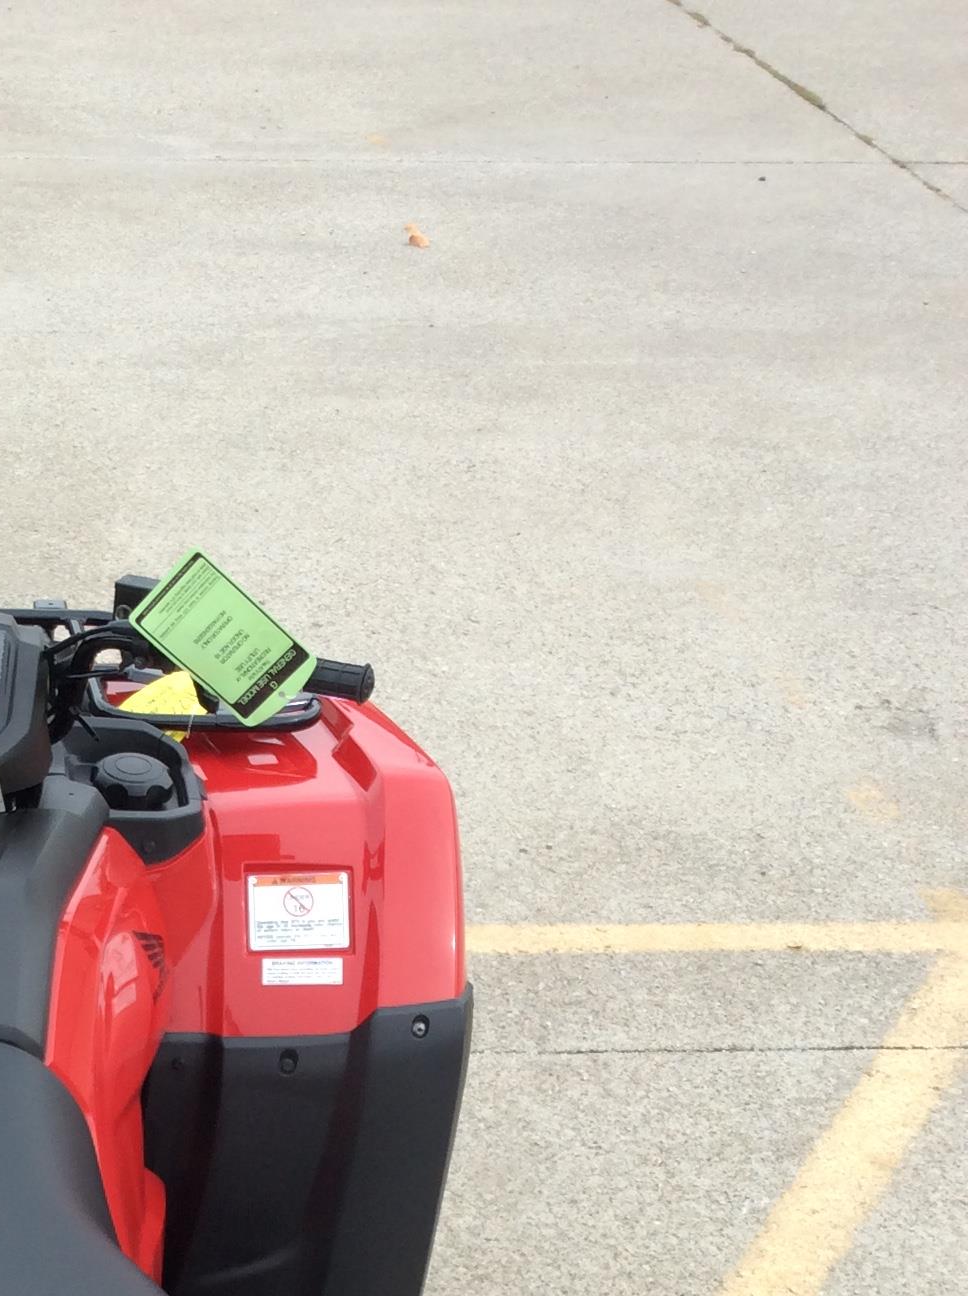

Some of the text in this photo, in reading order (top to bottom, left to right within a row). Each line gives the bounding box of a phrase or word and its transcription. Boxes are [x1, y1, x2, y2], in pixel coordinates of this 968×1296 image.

[266, 648, 298, 677] GENERAL
[255, 673, 272, 689] USE
[267, 679, 279, 690] G
[236, 683, 261, 707] MODEL
